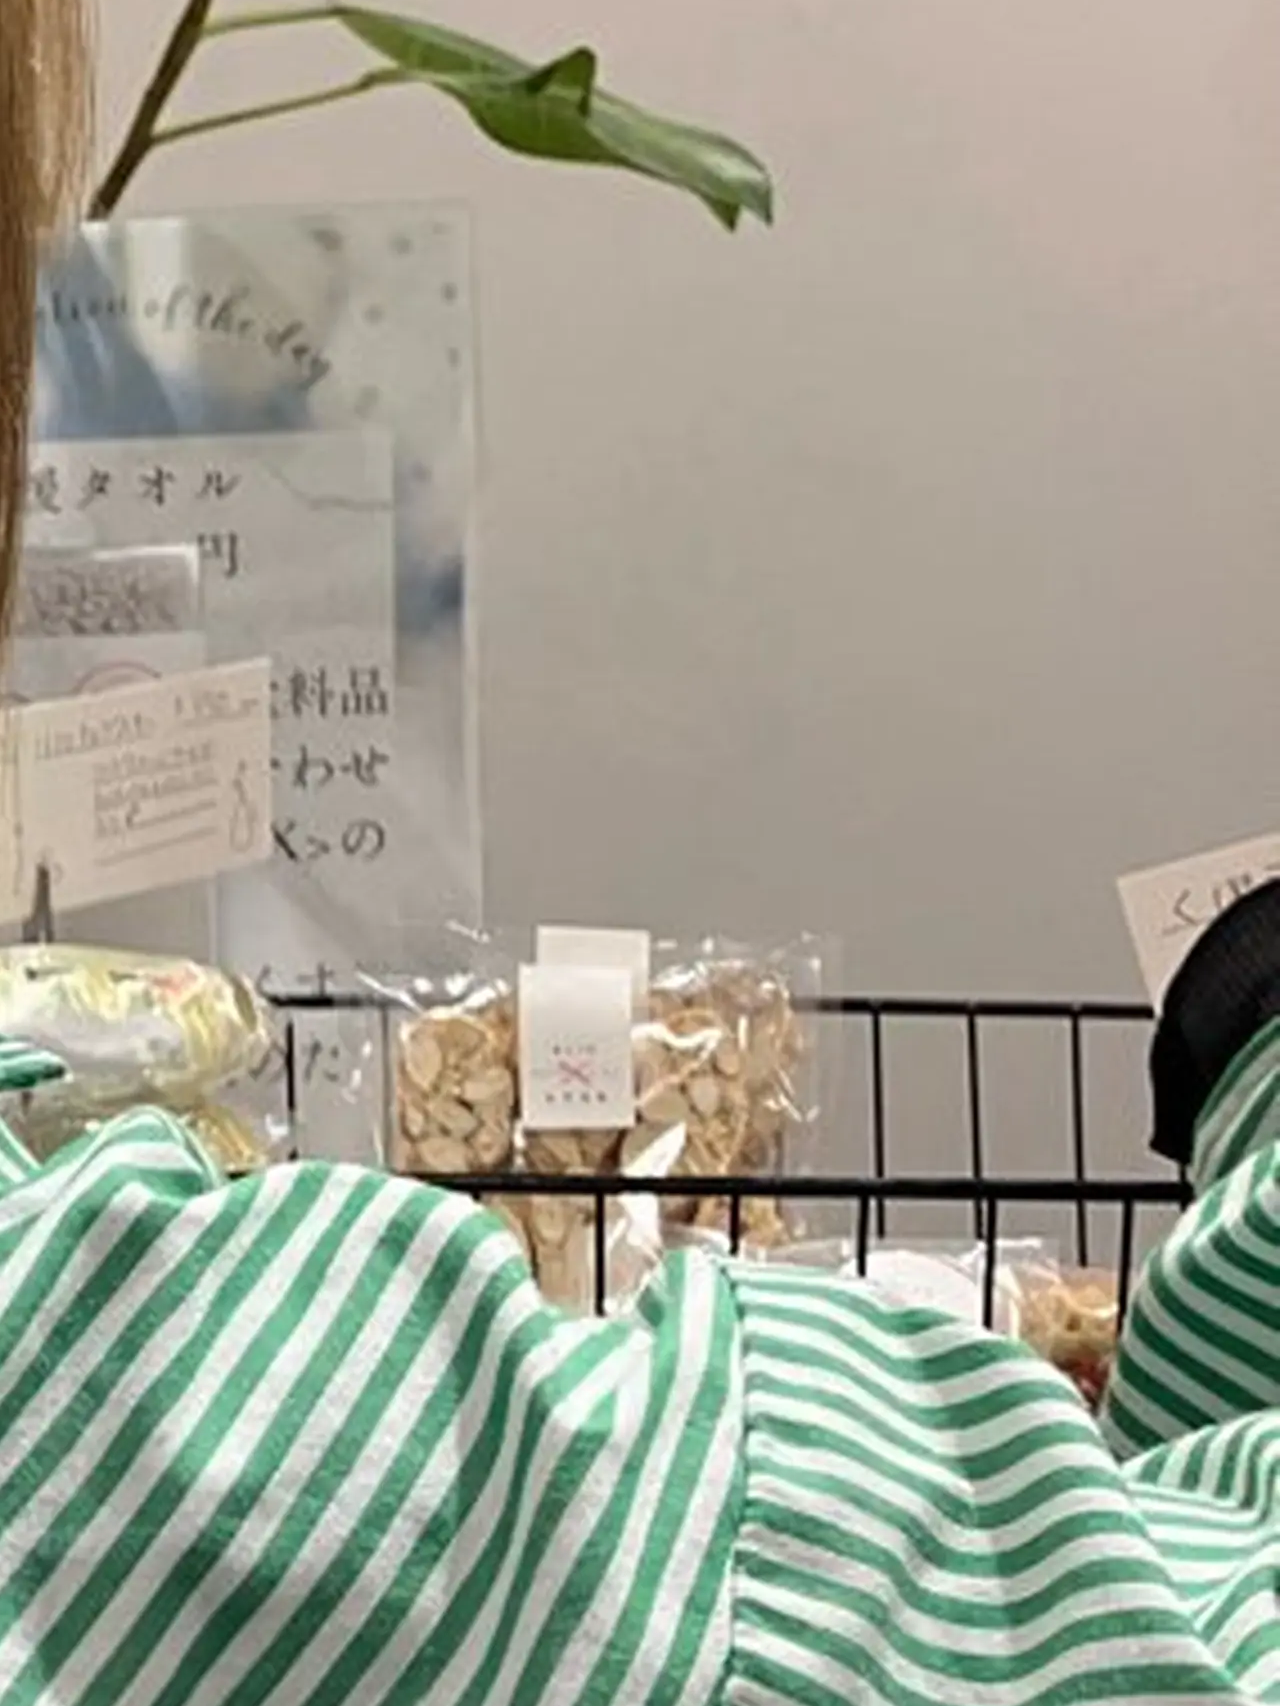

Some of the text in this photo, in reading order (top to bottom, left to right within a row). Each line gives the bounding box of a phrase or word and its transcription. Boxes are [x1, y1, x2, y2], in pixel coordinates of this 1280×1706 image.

[195, 284, 257, 337] the
[262, 319, 332, 392] day
[269, 666, 389, 721] 料品
[269, 744, 390, 789] わせ
